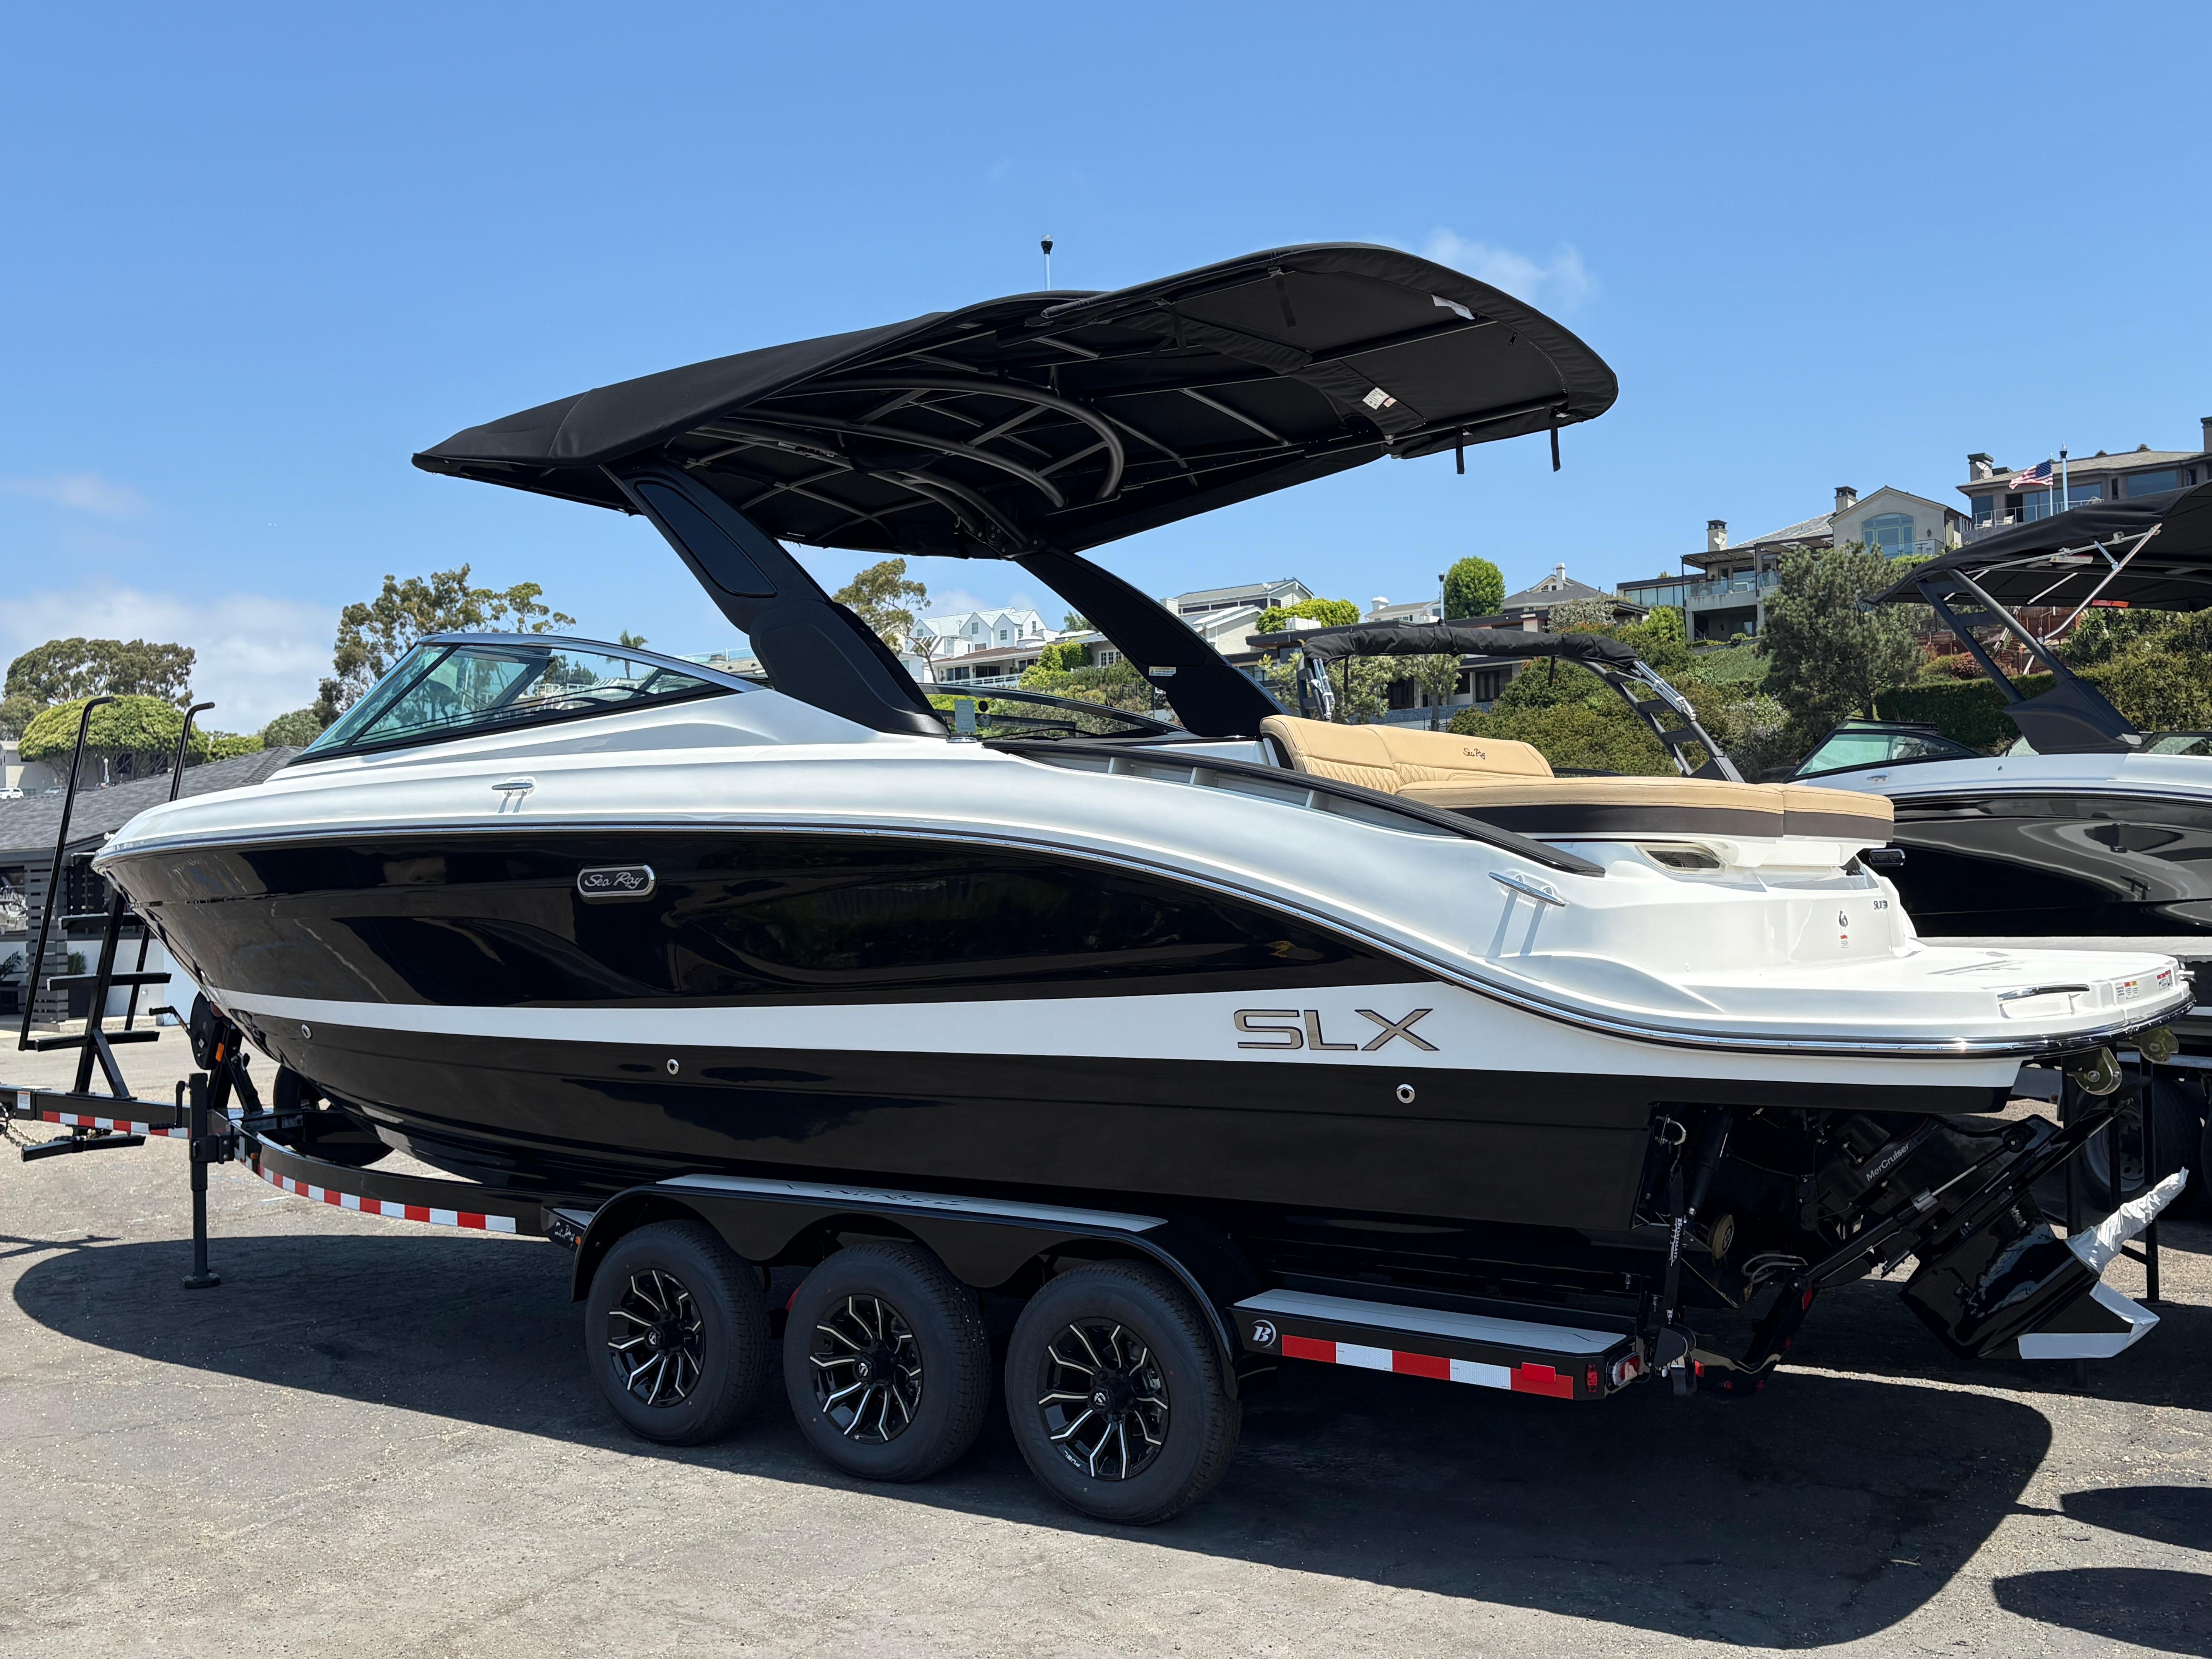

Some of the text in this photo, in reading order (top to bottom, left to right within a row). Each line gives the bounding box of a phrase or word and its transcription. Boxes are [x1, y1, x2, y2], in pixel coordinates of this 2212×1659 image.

[584, 872, 644, 889] Sea Ray
[1233, 1008, 1440, 1051] SLX
[1866, 1143, 1910, 1182] MerCruiser
[1064, 1450, 1081, 1468] FUEL
